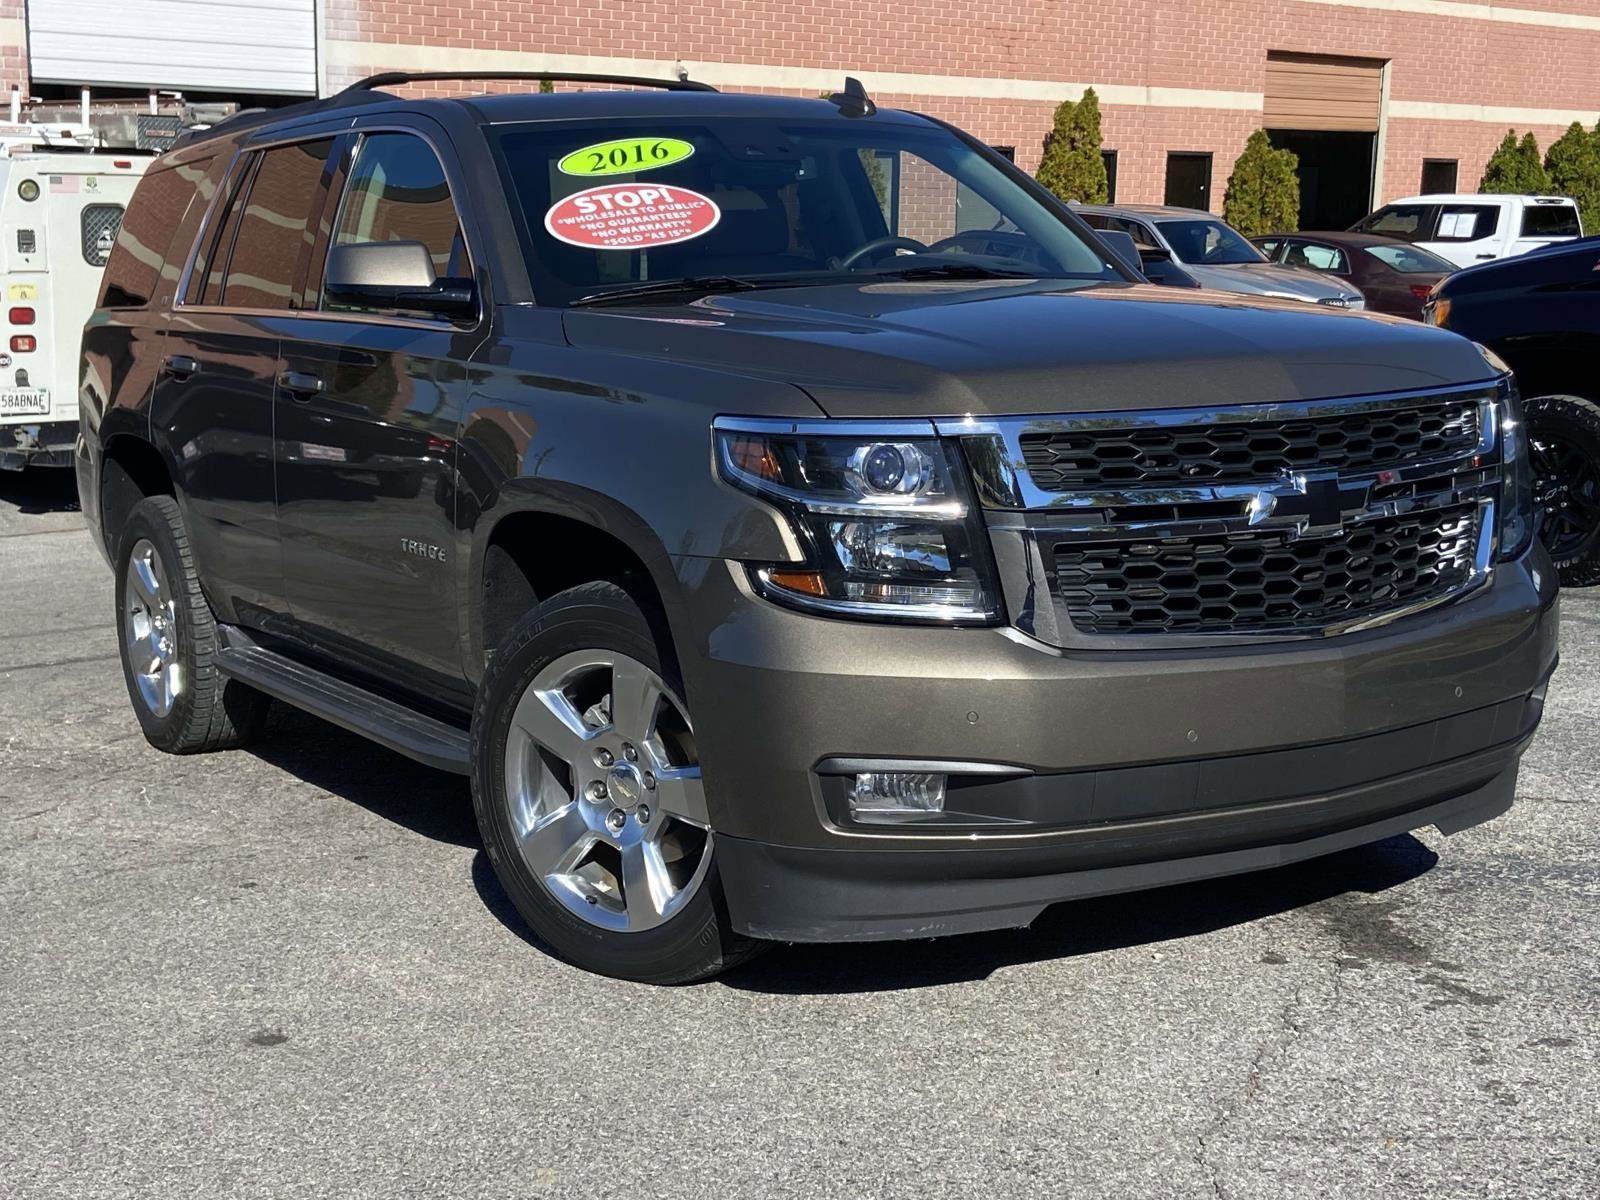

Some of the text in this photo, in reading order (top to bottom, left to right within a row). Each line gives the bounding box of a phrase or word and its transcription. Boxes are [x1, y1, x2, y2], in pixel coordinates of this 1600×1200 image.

[588, 141, 669, 172] 2016
[574, 188, 675, 214] STOP!
[639, 206, 656, 214] TO
[400, 537, 447, 563] TAHOE
